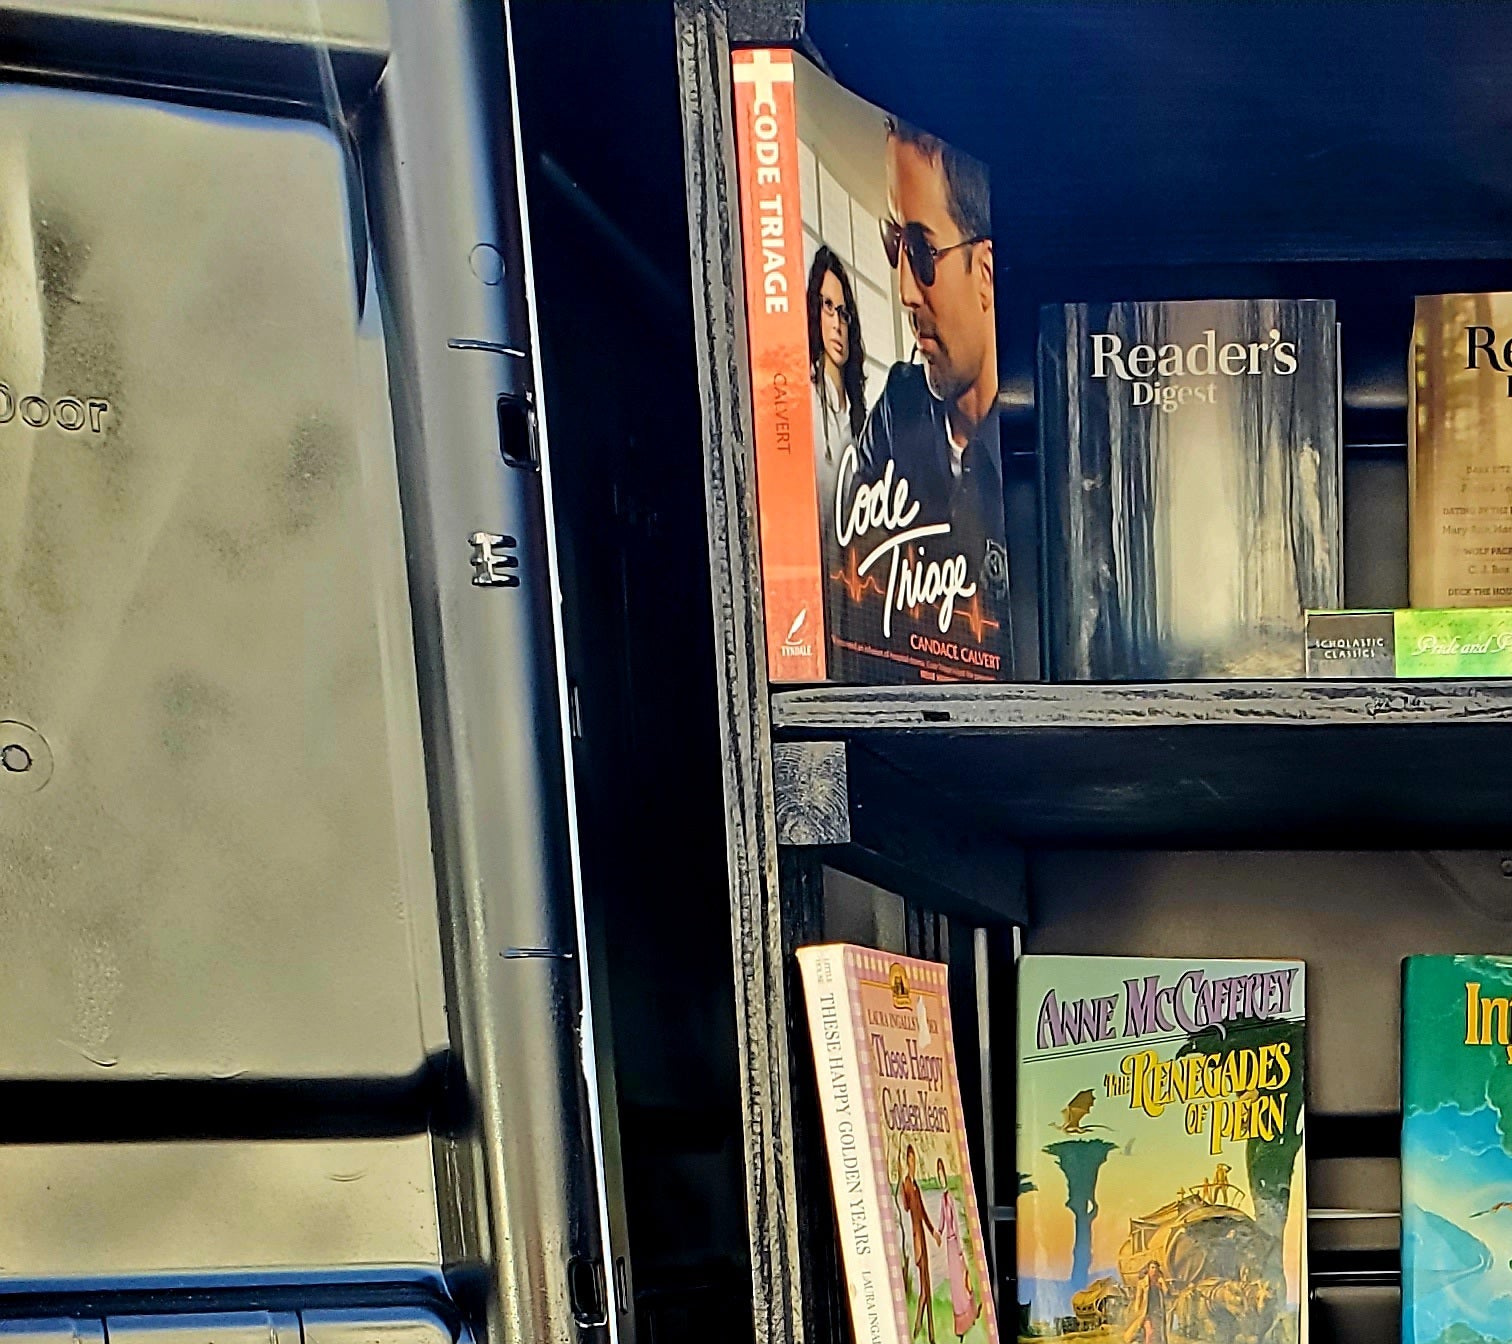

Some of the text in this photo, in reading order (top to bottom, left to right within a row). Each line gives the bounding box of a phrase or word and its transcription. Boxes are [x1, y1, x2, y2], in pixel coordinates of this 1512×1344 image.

[753, 101, 789, 313] CODE TRIAGE
[1090, 328, 1297, 380] Reader's
[771, 372, 792, 455] CALVERT
[1132, 381, 1217, 413] Digest
[834, 443, 920, 547] Code
[857, 522, 977, 639] Triage
[910, 633, 959, 660] CANDACE
[960, 647, 1001, 671] CALVERT
[1314, 637, 1385, 650] SCHOLASTIC
[1324, 648, 1376, 660] CLASSICS
[1460, 636, 1488, 655] and
[820, 993, 842, 1052] THESE
[1037, 989, 1118, 1050] ANNE
[829, 1057, 850, 1118] HAPPY
[871, 1033, 943, 1092] These Happy
[1104, 1042, 1290, 1117] THE RENEGADES
[882, 1087, 950, 1133] Golden Years
[1186, 1094, 1287, 1155] OF PERN
[838, 1122, 862, 1194] GOLDEN
[849, 1196, 871, 1256] YEARS
